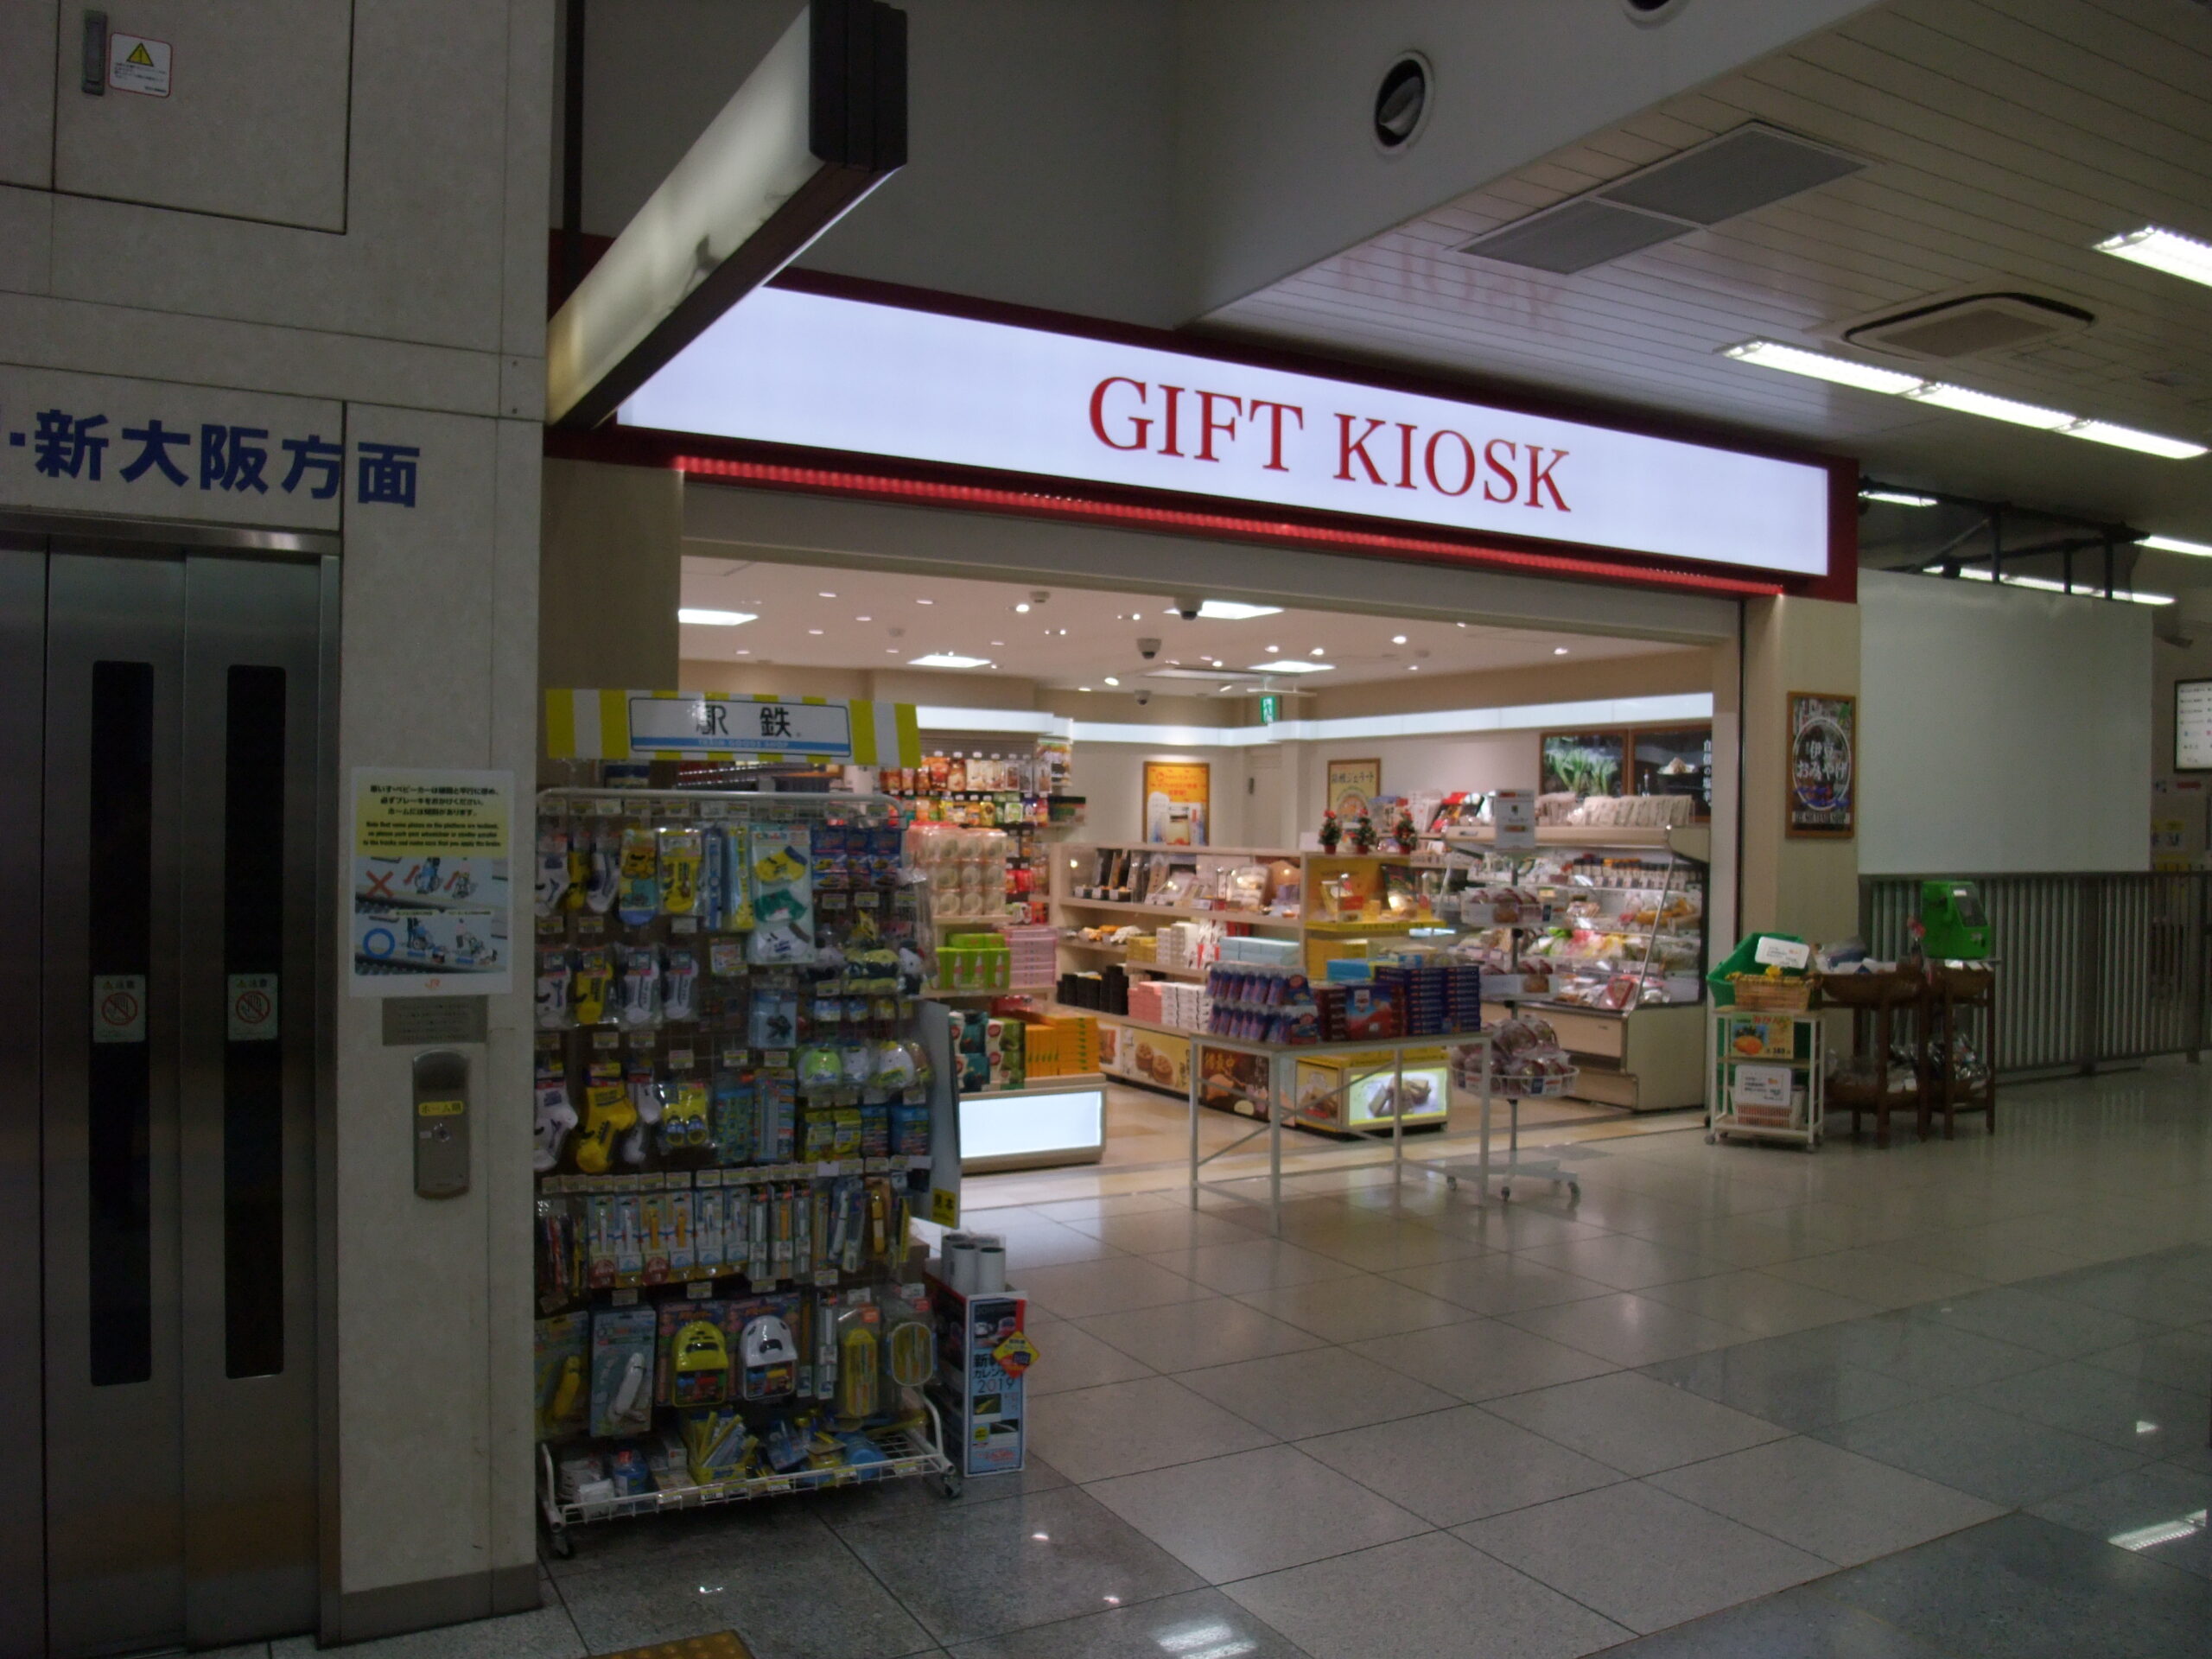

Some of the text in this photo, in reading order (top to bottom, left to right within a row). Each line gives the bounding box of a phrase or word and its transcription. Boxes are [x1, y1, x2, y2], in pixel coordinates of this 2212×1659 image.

[1089, 376, 1572, 512] GIFT KIOSK
[978, 1377, 1015, 1394] 2019
